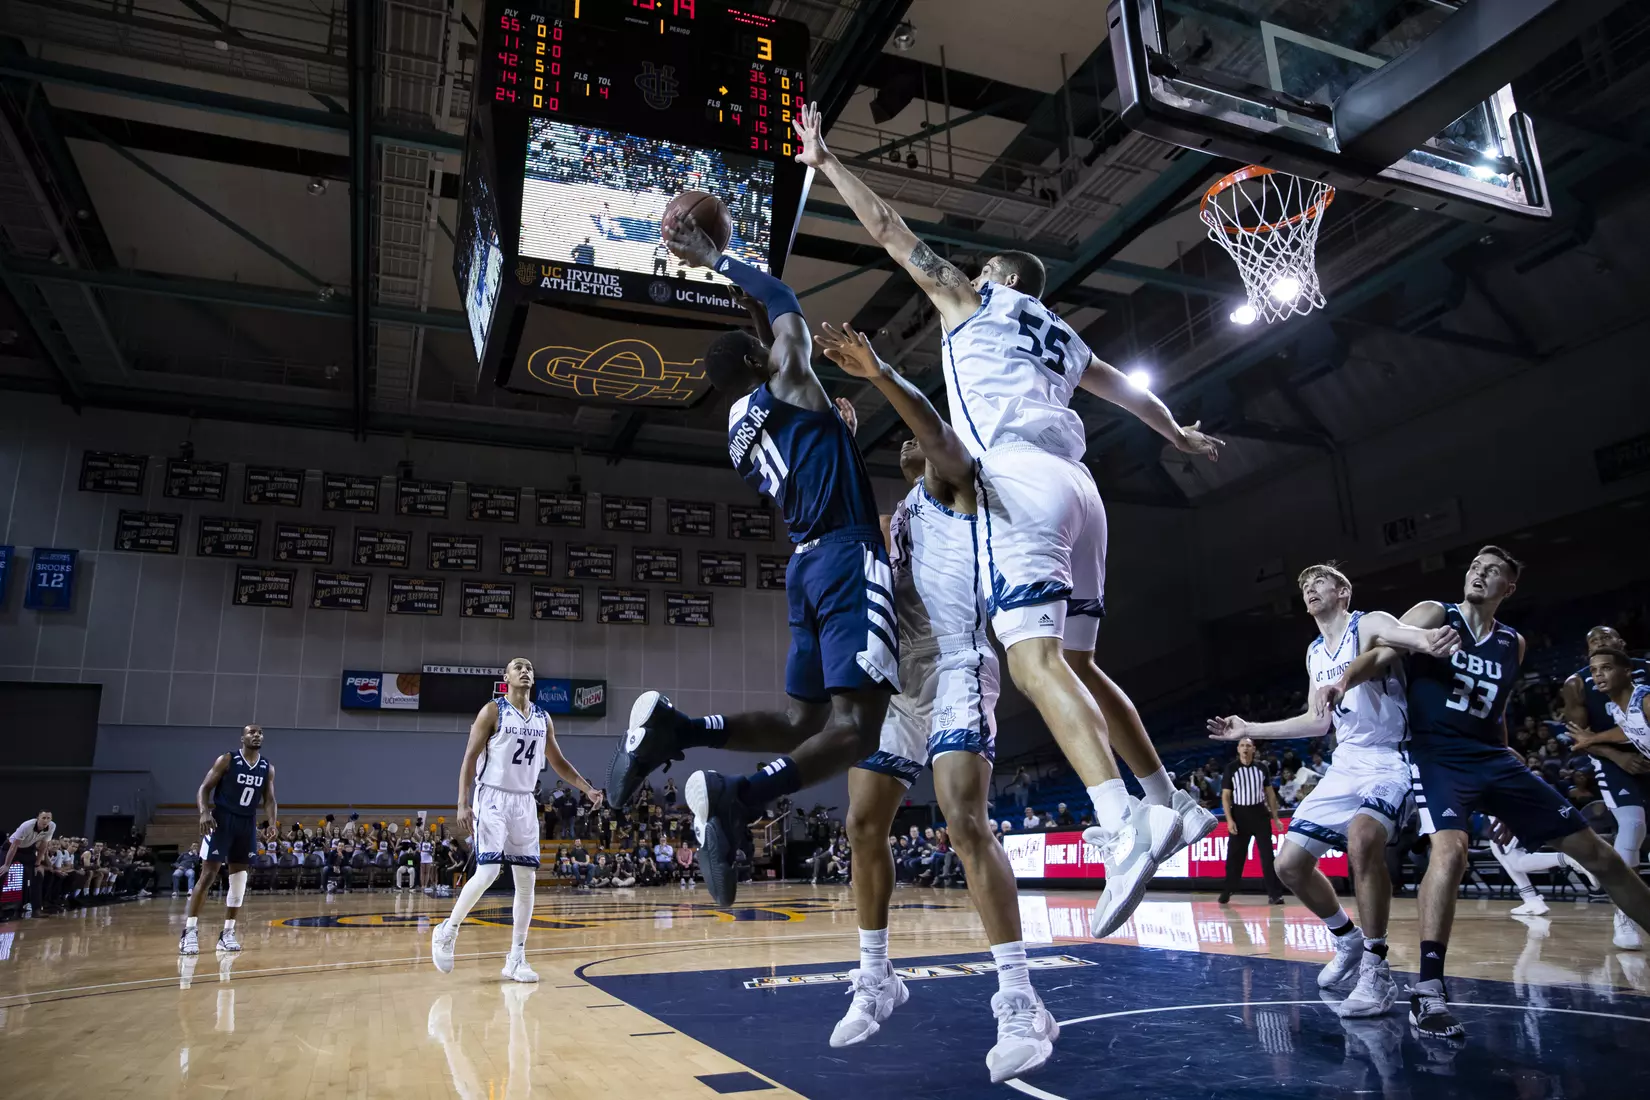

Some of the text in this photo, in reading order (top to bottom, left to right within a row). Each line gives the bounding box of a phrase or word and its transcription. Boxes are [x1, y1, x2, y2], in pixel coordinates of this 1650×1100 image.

[504, 8, 518, 18] PLY
[530, 14, 545, 23] PTS
[500, 16, 520, 32] 55
[537, 24, 546, 38] 0
[554, 20, 563, 28] FL
[670, 25, 690, 35] PERIOD
[504, 34, 519, 49] 11
[553, 28, 563, 41] 0
[536, 42, 546, 55] 2
[552, 45, 562, 58] 0
[757, 36, 772, 61] 3
[498, 52, 518, 66] 42
[535, 58, 545, 73] 5
[551, 62, 560, 76] 0
[752, 62, 764, 71] PLY
[774, 67, 788, 76] PTS
[503, 70, 517, 84] 14
[534, 76, 544, 90] 0
[574, 72, 588, 81] FLS
[598, 76, 612, 86] TOL
[750, 70, 766, 84] 35
[781, 77, 790, 90] 0
[556, 80, 560, 93] 1
[586, 83, 590, 97] 1
[600, 87, 609, 100] 4
[750, 86, 767, 100] 33
[495, 87, 516, 102] 24
[533, 94, 542, 108] 0
[782, 93, 790, 106] 0
[549, 97, 559, 111] 0
[707, 99, 720, 108] FLS
[730, 103, 743, 112] TOL
[760, 104, 767, 117] 0
[732, 113, 740, 126] 4
[782, 109, 790, 122] 2
[755, 120, 767, 134] 15
[751, 137, 768, 151] 31
[783, 143, 791, 156] 0
[541, 264, 620, 287] UC IRVINE
[540, 277, 623, 298] ATHLETICS
[676, 289, 694, 302] UC
[696, 292, 730, 308] Irvine
[1016, 310, 1071, 375] 55
[748, 405, 770, 428] JR.
[750, 428, 789, 498] 31
[36, 563, 72, 572] BROOKS
[38, 572, 64, 588] 12
[1451, 649, 1502, 679] CBU
[346, 677, 380, 686] PEPSI
[538, 690, 568, 702] AQUAFINA
[1446, 673, 1499, 720] 33
[520, 728, 545, 737] IRVINE
[512, 738, 536, 765] 24
[237, 773, 263, 787] CBU
[240, 786, 255, 806] 0
[1046, 844, 1066, 864] DINE
[1067, 844, 1077, 864] IN
